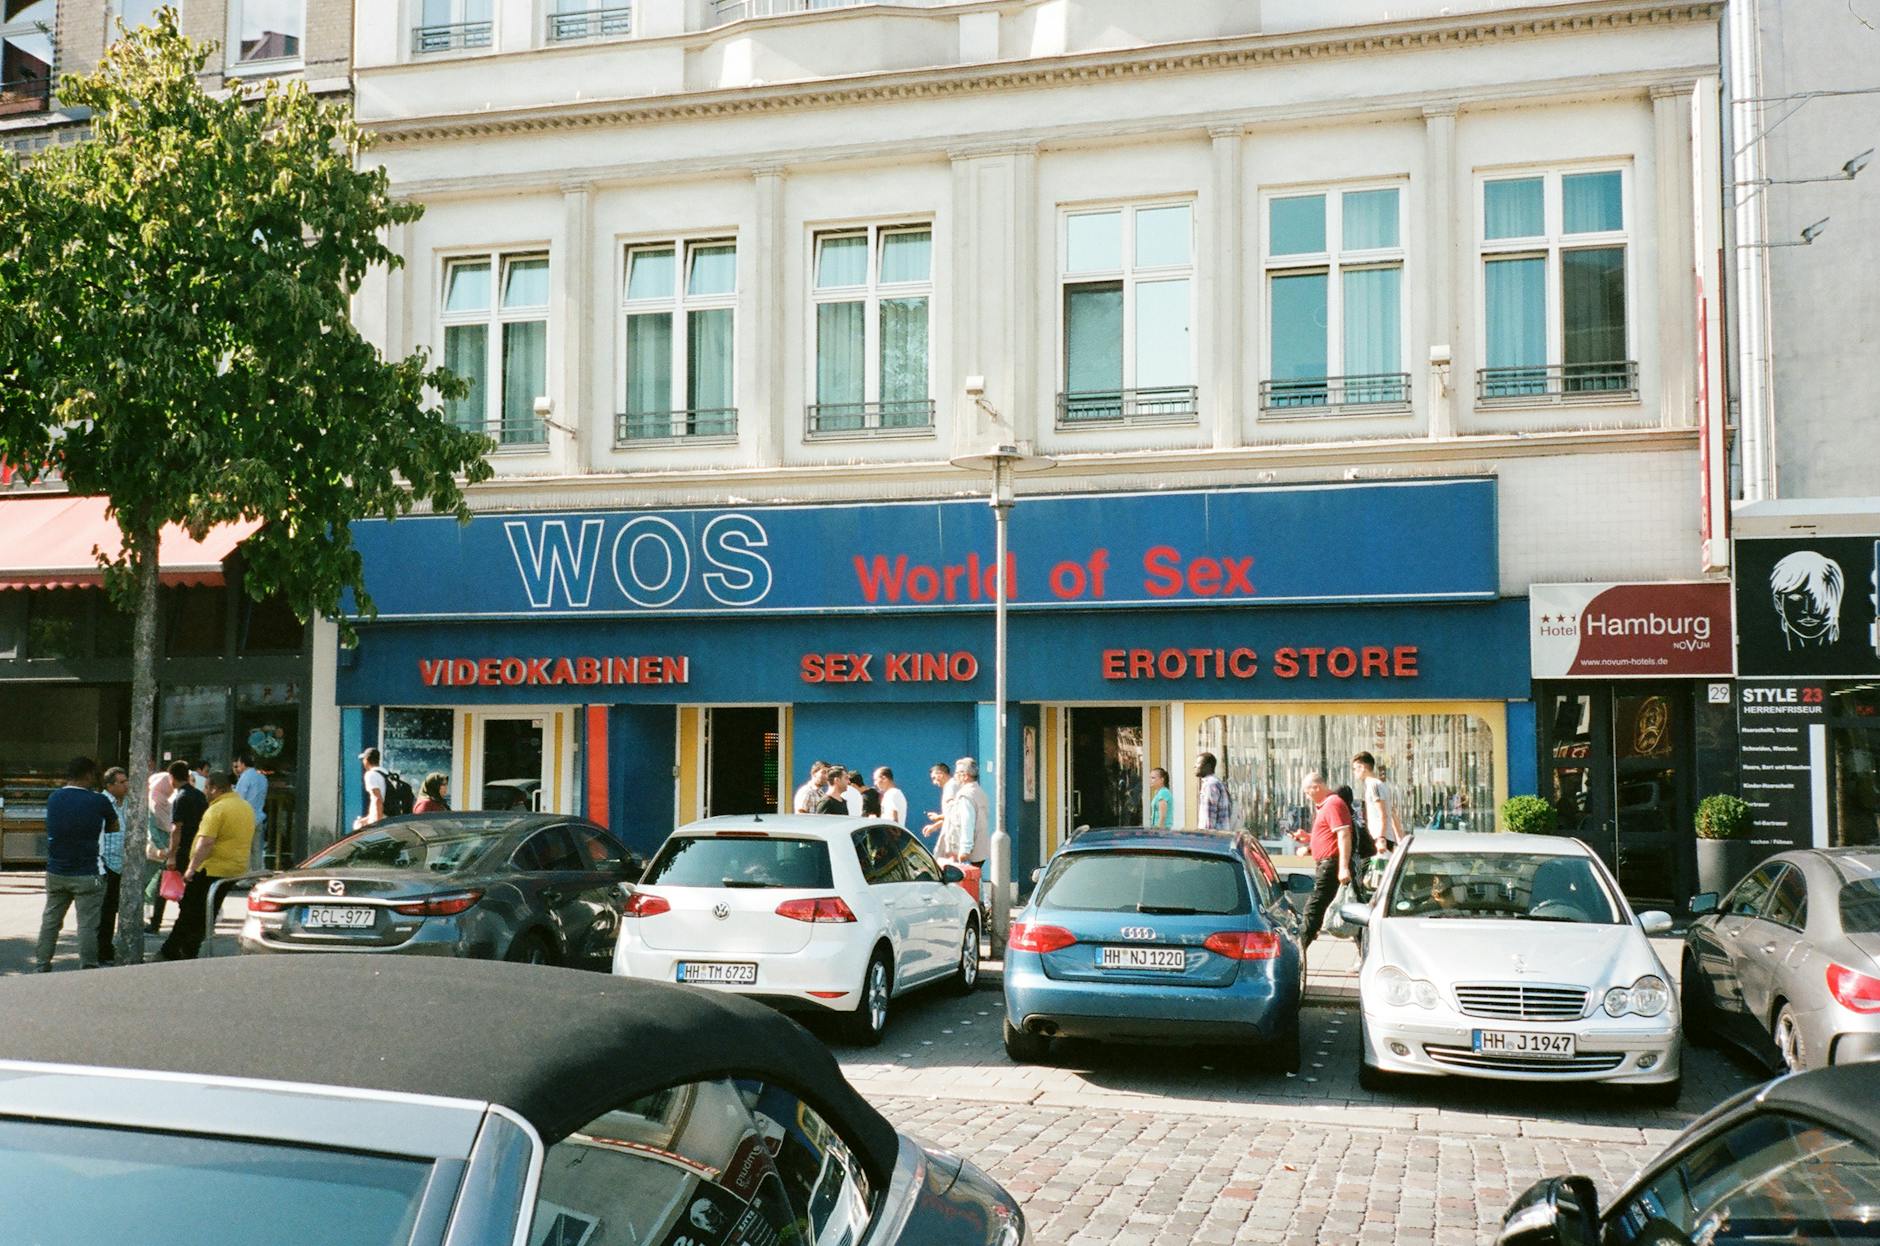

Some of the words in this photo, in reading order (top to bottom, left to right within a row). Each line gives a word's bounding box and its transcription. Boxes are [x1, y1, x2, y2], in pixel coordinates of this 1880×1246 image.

[504, 513, 773, 608] WOS
[853, 551, 1018, 603] World
[1049, 548, 1109, 600] of
[1143, 545, 1256, 598] Sex
[1540, 625, 1577, 636] Hotel
[1587, 613, 1711, 640] Hamburg
[800, 652, 873, 683] SEX
[885, 651, 979, 682] KINO
[1103, 648, 1258, 679] EROTIC
[1273, 646, 1419, 678] STORE
[1580, 657, 1669, 666] www.novum-hotels.de
[419, 656, 689, 687] VIDEOKABINEN
[1710, 686, 1729, 700] 29
[1743, 688, 1798, 703] STYLE
[1802, 687, 1824, 704] 23
[1743, 705, 1822, 714] HERRENFRISEUR
[310, 909, 371, 925] RCL-977
[1104, 949, 1121, 964] HH
[1130, 950, 1147, 965] NJ
[1150, 951, 1182, 966] 1220
[685, 966, 700, 979] HH
[708, 966, 722, 979] TM
[726, 967, 754, 980] 6723
[1483, 1032, 1505, 1049] HH
[1517, 1035, 1528, 1051] J
[1531, 1035, 1571, 1052] 1947
